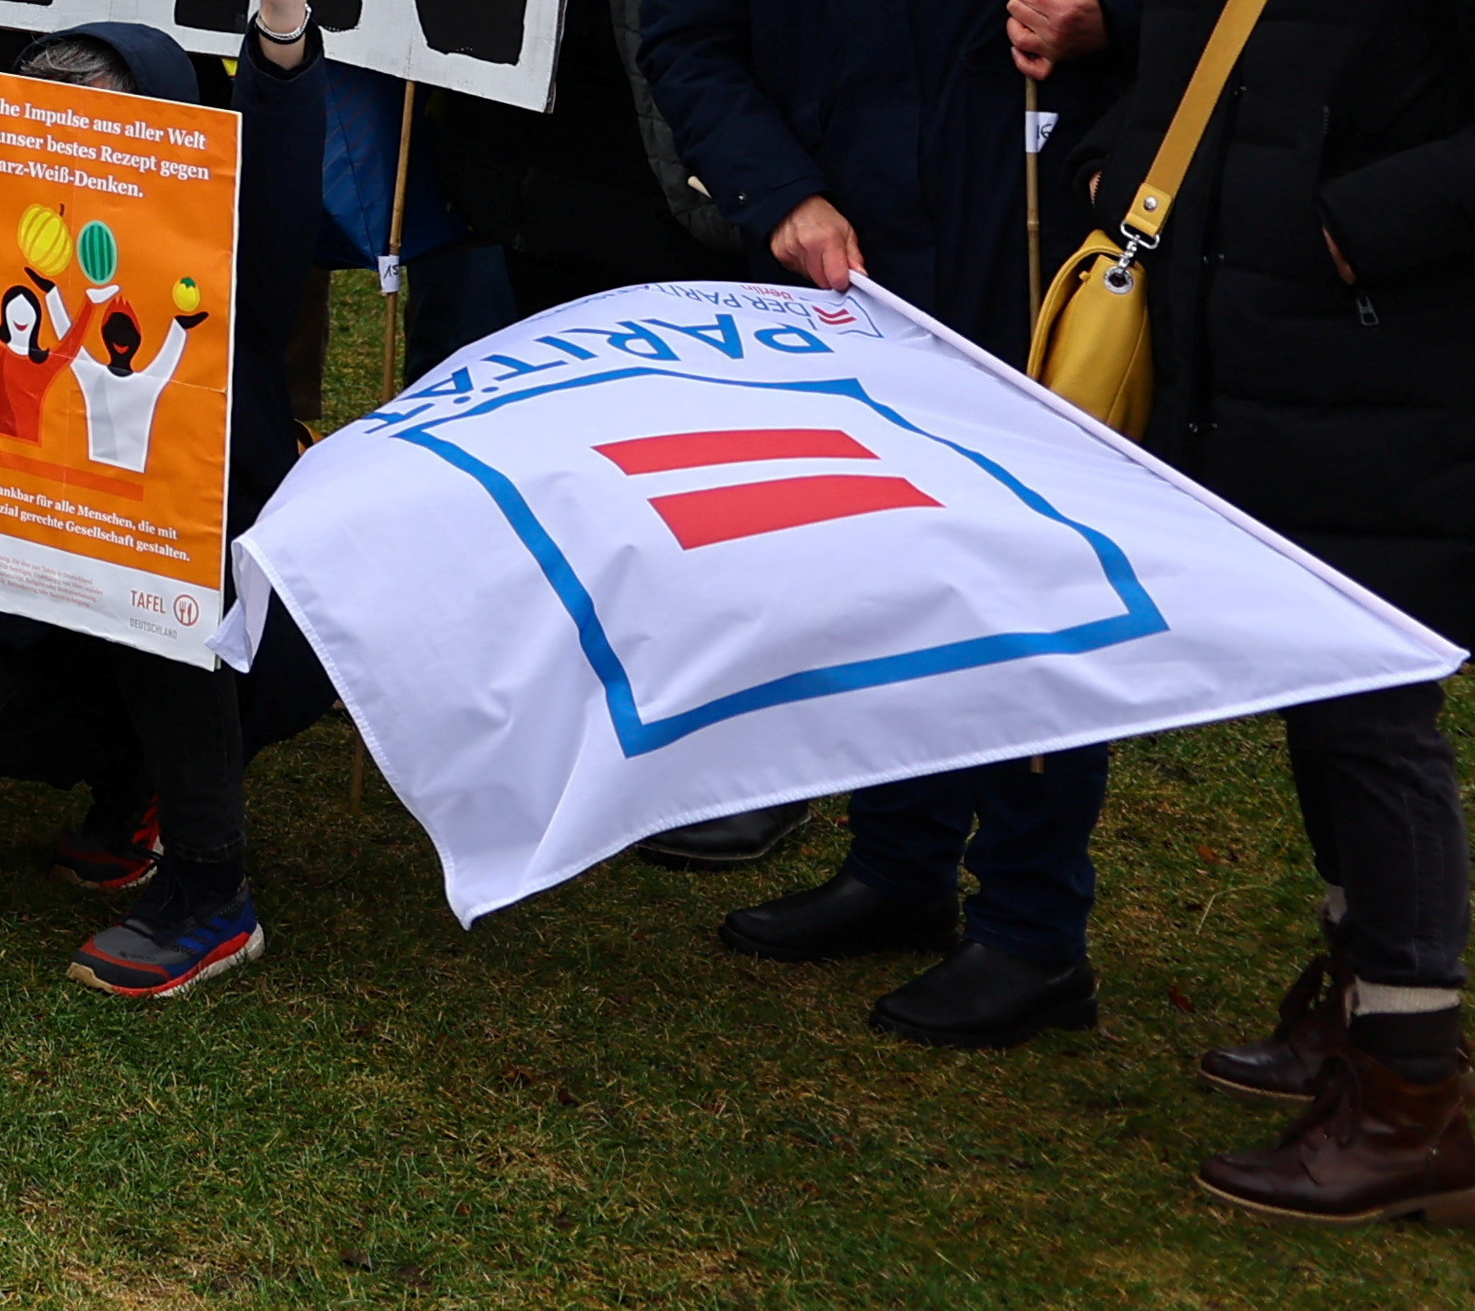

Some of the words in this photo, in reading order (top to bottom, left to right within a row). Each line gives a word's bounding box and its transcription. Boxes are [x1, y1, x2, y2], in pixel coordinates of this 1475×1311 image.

[23, 102, 89, 131] Impulse
[92, 116, 121, 135] aus
[124, 118, 164, 143] aller
[166, 126, 207, 151] Welt
[47, 134, 98, 161] bestes
[99, 145, 157, 176] Rezept
[159, 156, 210, 182] gegen
[744, 294, 811, 318] DER
[360, 313, 836, 435] PARITÄT
[20, 506, 64, 533] gerechte
[65, 516, 135, 550] Gesellschaft
[136, 531, 191, 563] gestalten.
[36, 490, 53, 507] für
[55, 495, 75, 513] alle
[77, 499, 136, 531] Menschen,
[138, 516, 155, 534] die
[157, 521, 178, 541] mit
[129, 589, 167, 615] TAFEL
[128, 616, 178, 641] DEUTSCHLAND
